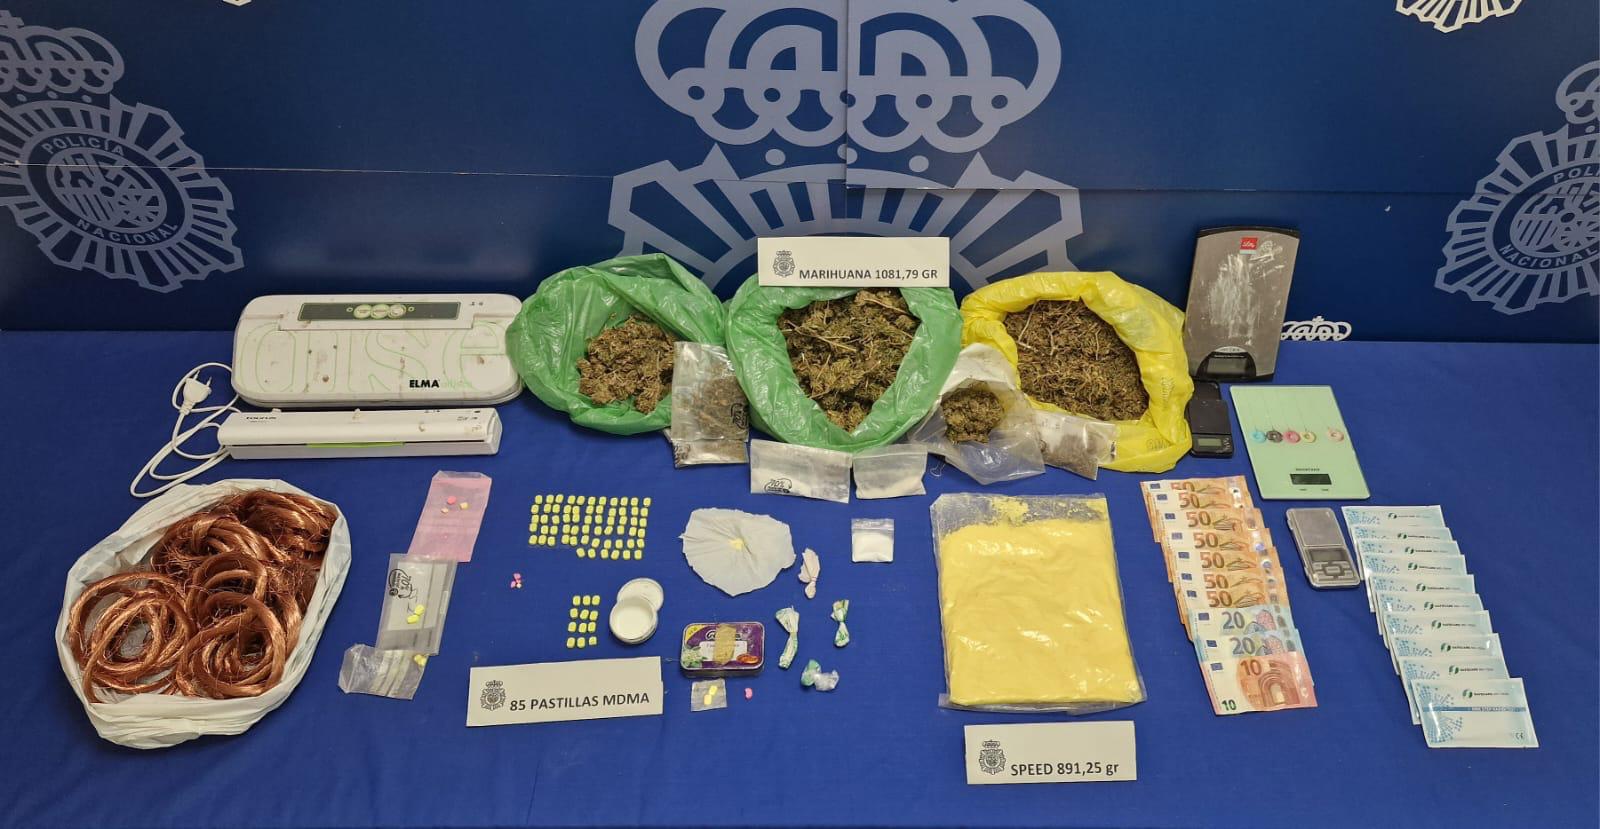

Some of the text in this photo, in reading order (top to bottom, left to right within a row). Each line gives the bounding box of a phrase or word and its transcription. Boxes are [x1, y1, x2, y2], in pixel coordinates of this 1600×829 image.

[75, 217, 178, 244] NACIONAL
[1500, 243, 1598, 268] NACIONAL
[799, 269, 938, 281] MARIHUANA 1081,79 GR
[409, 379, 440, 388] ELMA
[1186, 511, 1211, 527] 50
[1194, 532, 1219, 549] 50
[1202, 552, 1225, 569] 50
[1204, 574, 1229, 590] 50
[1209, 590, 1233, 608] 50
[1222, 611, 1246, 630] 20
[1230, 637, 1256, 656] 20
[1241, 659, 1262, 676] 10
[510, 692, 650, 711] 85 PASTILLAS MDMA
[1222, 699, 1237, 711] 10
[1011, 762, 1119, 776] SPEED 891,25 gr
